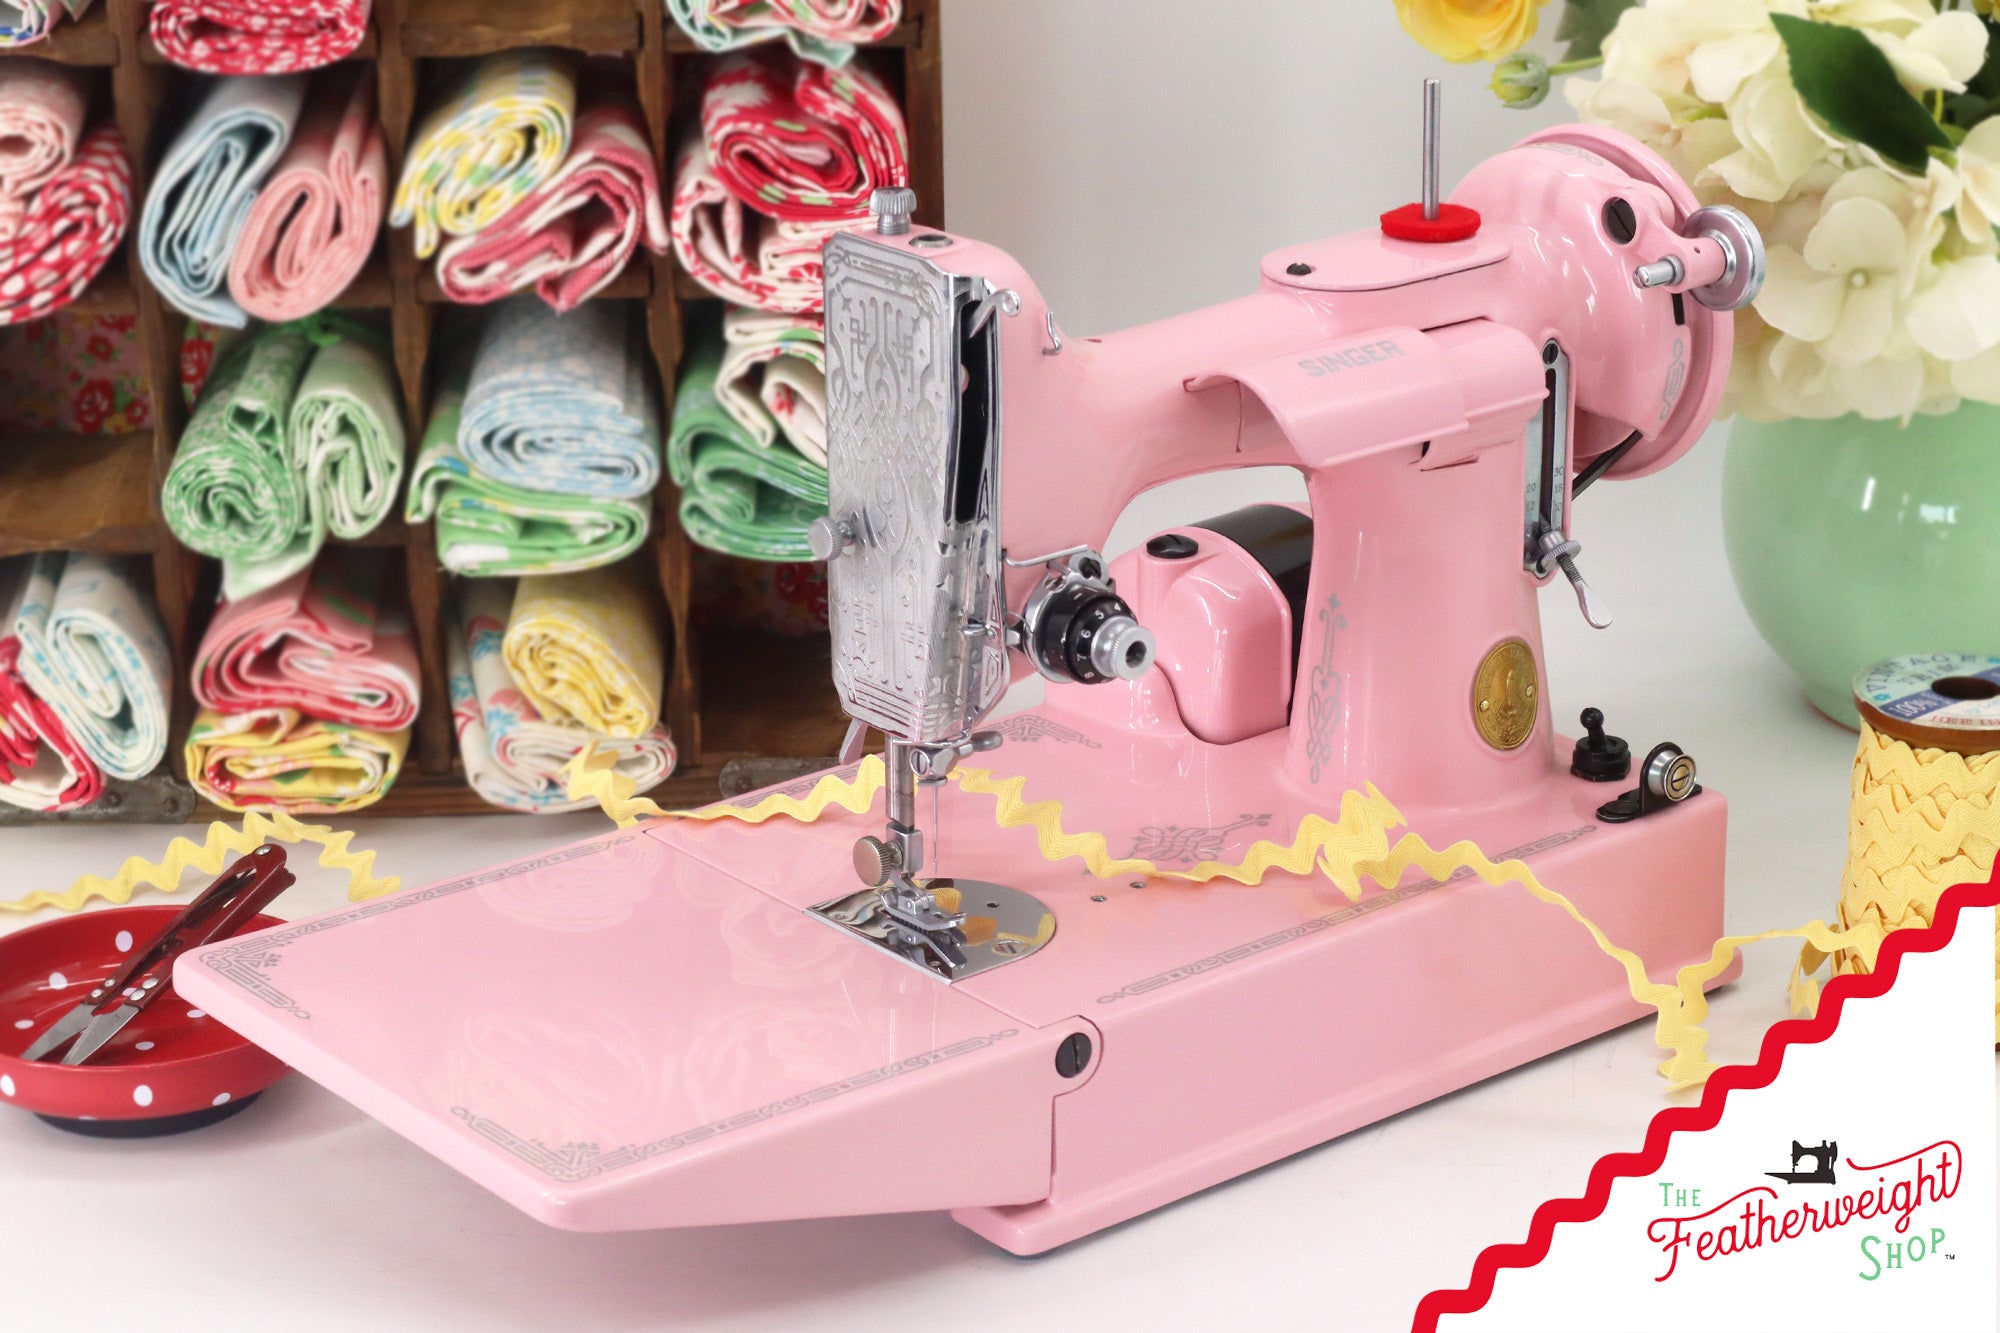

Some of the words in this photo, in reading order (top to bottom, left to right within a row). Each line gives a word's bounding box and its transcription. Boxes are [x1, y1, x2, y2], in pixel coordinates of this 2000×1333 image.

[1298, 340, 1406, 377] SINGER
[1554, 466, 1563, 477] 30
[1526, 483, 1536, 494] 20
[1554, 484, 1563, 494] 15
[1095, 610, 1104, 619] 5
[1081, 630, 1091, 639] 6
[1084, 671, 1094, 679] 8
